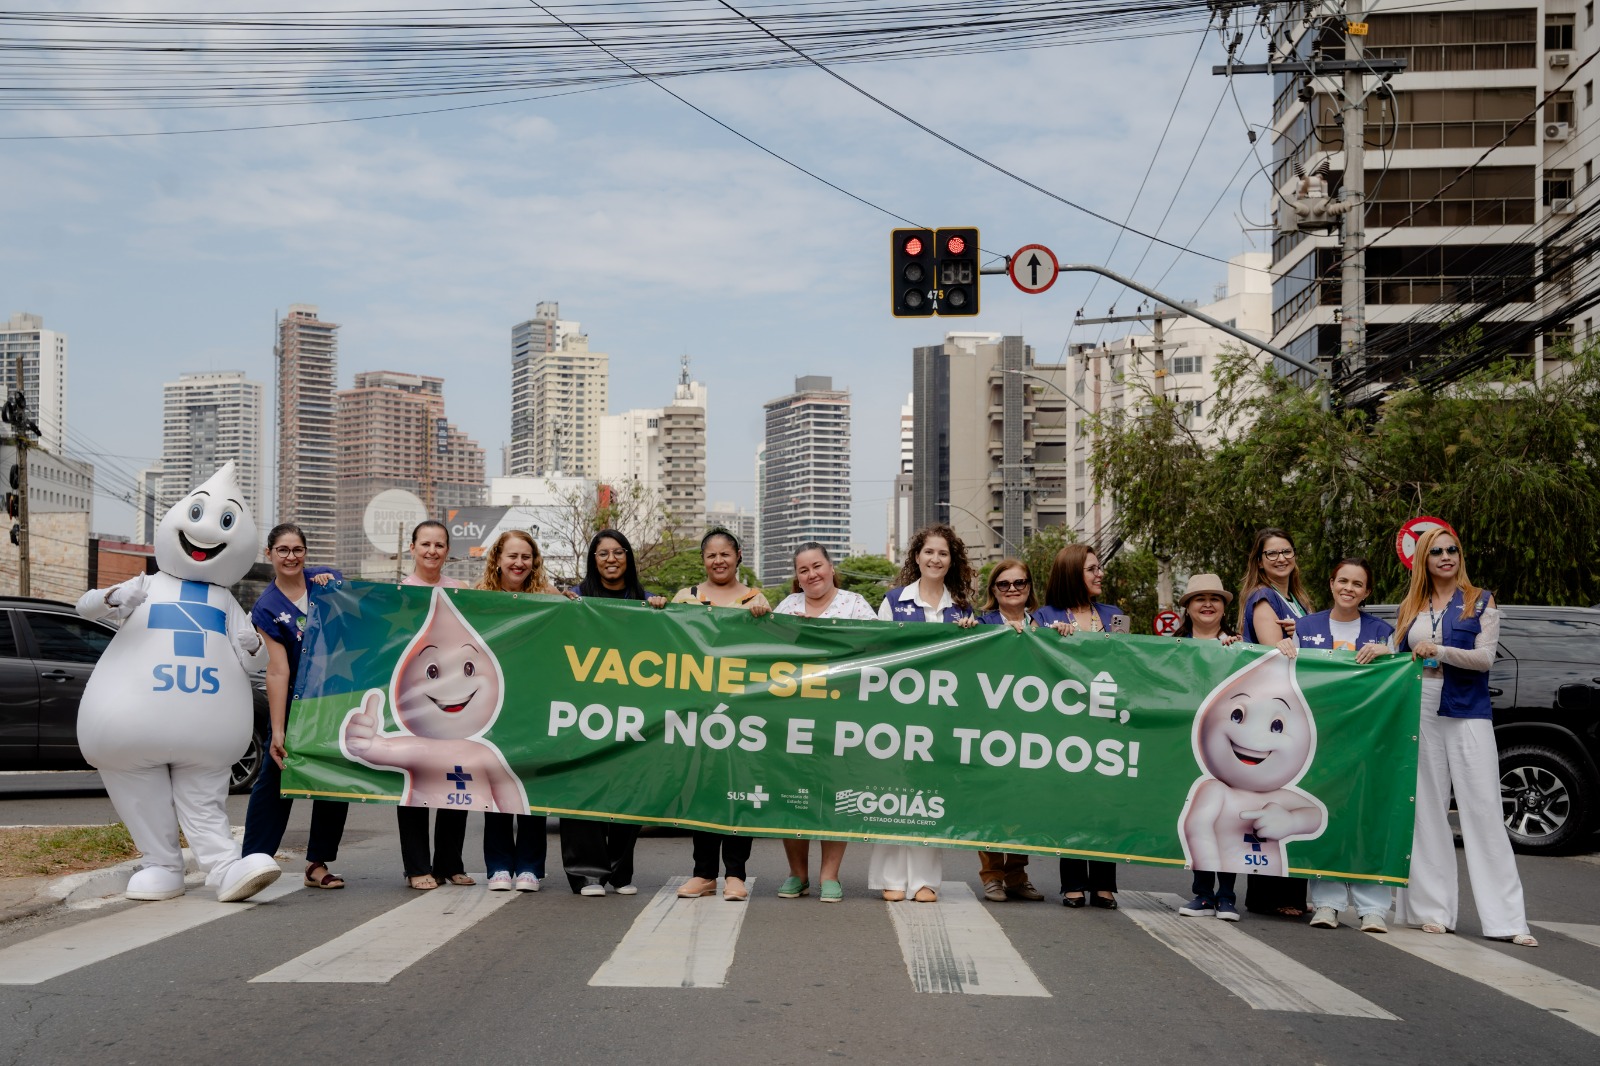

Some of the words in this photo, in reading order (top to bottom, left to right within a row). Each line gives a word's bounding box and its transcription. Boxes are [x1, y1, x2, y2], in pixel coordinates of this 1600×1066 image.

[927, 290, 944, 300] 475
[932, 300, 938, 309] A
[373, 510, 417, 521] BURGER
[451, 521, 487, 539] city
[152, 664, 220, 695] SUS
[564, 644, 841, 700] VACINE-SE.
[858, 665, 959, 707] POR
[976, 671, 1131, 725] VOCÊ,
[547, 700, 647, 742] POR
[664, 702, 768, 752] NÓS
[785, 718, 816, 755] E
[833, 720, 935, 762] POR
[952, 727, 1140, 778] TODOS!
[865, 785, 915, 793] GOVERNO
[446, 793, 473, 805] SUS
[726, 791, 746, 801] SUS
[856, 789, 945, 819] GOIÁS
[1244, 854, 1269, 866] SUS
